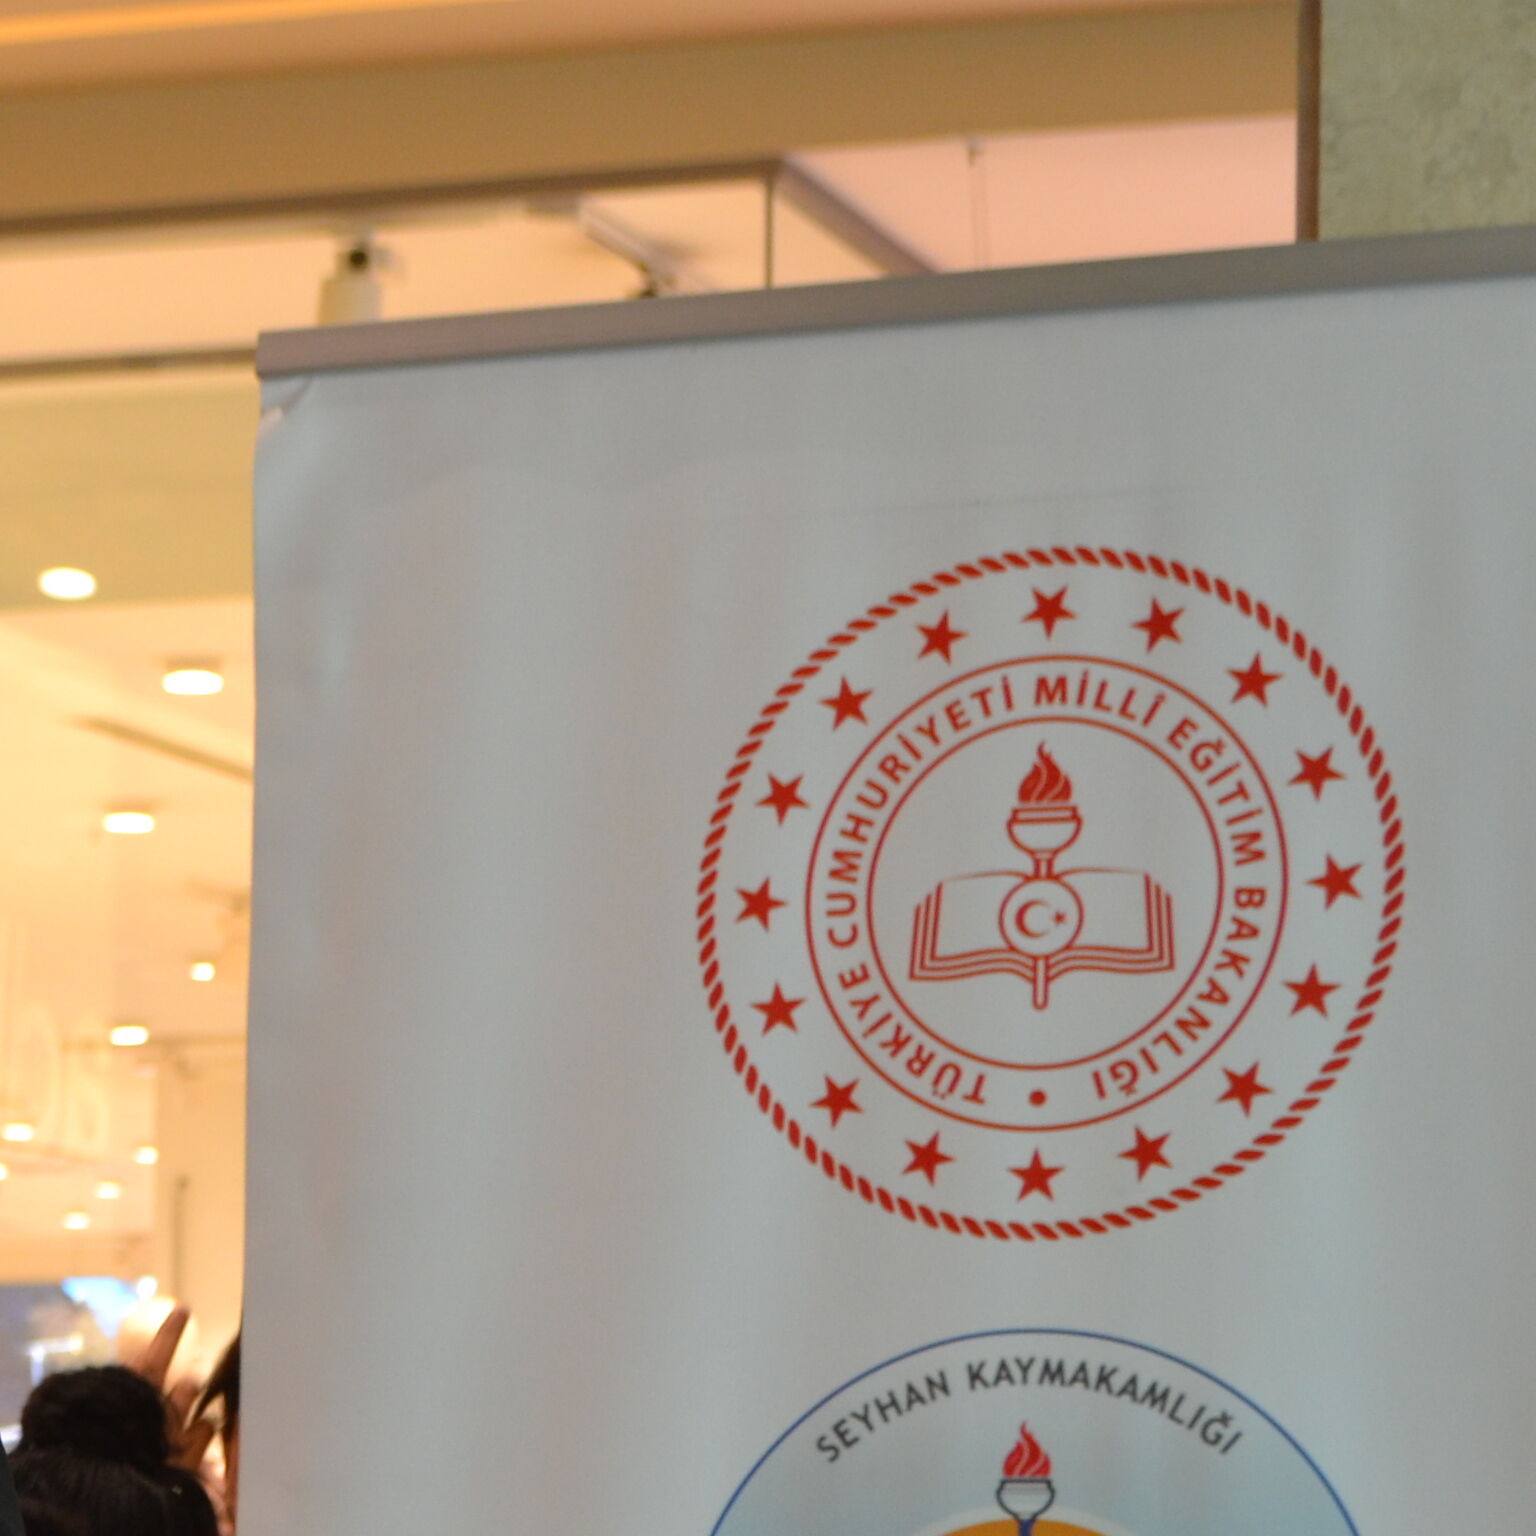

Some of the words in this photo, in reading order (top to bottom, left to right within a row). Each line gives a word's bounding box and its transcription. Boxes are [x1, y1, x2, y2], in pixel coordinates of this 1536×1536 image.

[825, 675, 1016, 950] CUMHURİYETİ
[1166, 716, 1268, 867] EĞİTİM
[837, 962, 988, 1106] TÜRKİYE
[1091, 886, 1269, 1101] BAKANLIĞI
[815, 1370, 952, 1463] SEYHAN
[965, 1356, 1244, 1456] KAYMAKAMLIĞI
